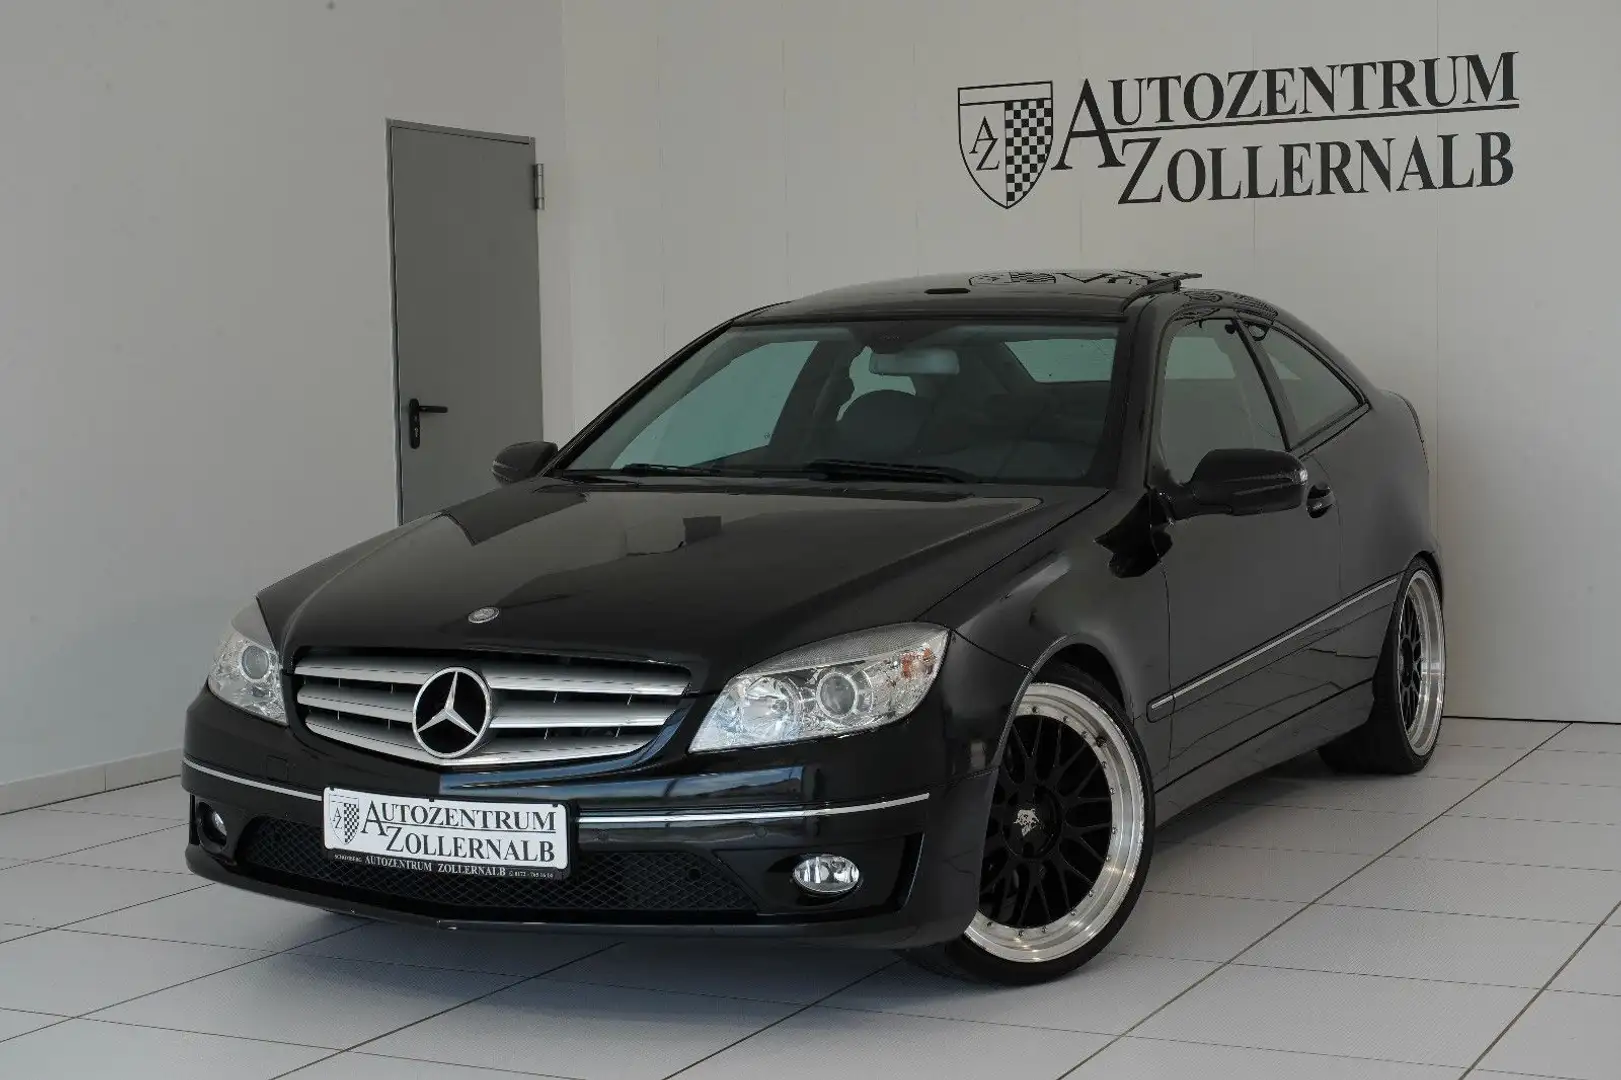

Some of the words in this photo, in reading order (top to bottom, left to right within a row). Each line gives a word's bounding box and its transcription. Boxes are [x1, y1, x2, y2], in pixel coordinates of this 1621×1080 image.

[1051, 51, 1519, 171] AUTOZENTRUM
[1118, 131, 1514, 205] ZOLLERNALB
[361, 800, 556, 836] AUTOZENTRUM
[385, 826, 555, 863] ZOLLERNALB
[364, 855, 432, 872] AUTOZENTRUM
[438, 863, 506, 876] ZOLLERNALB
